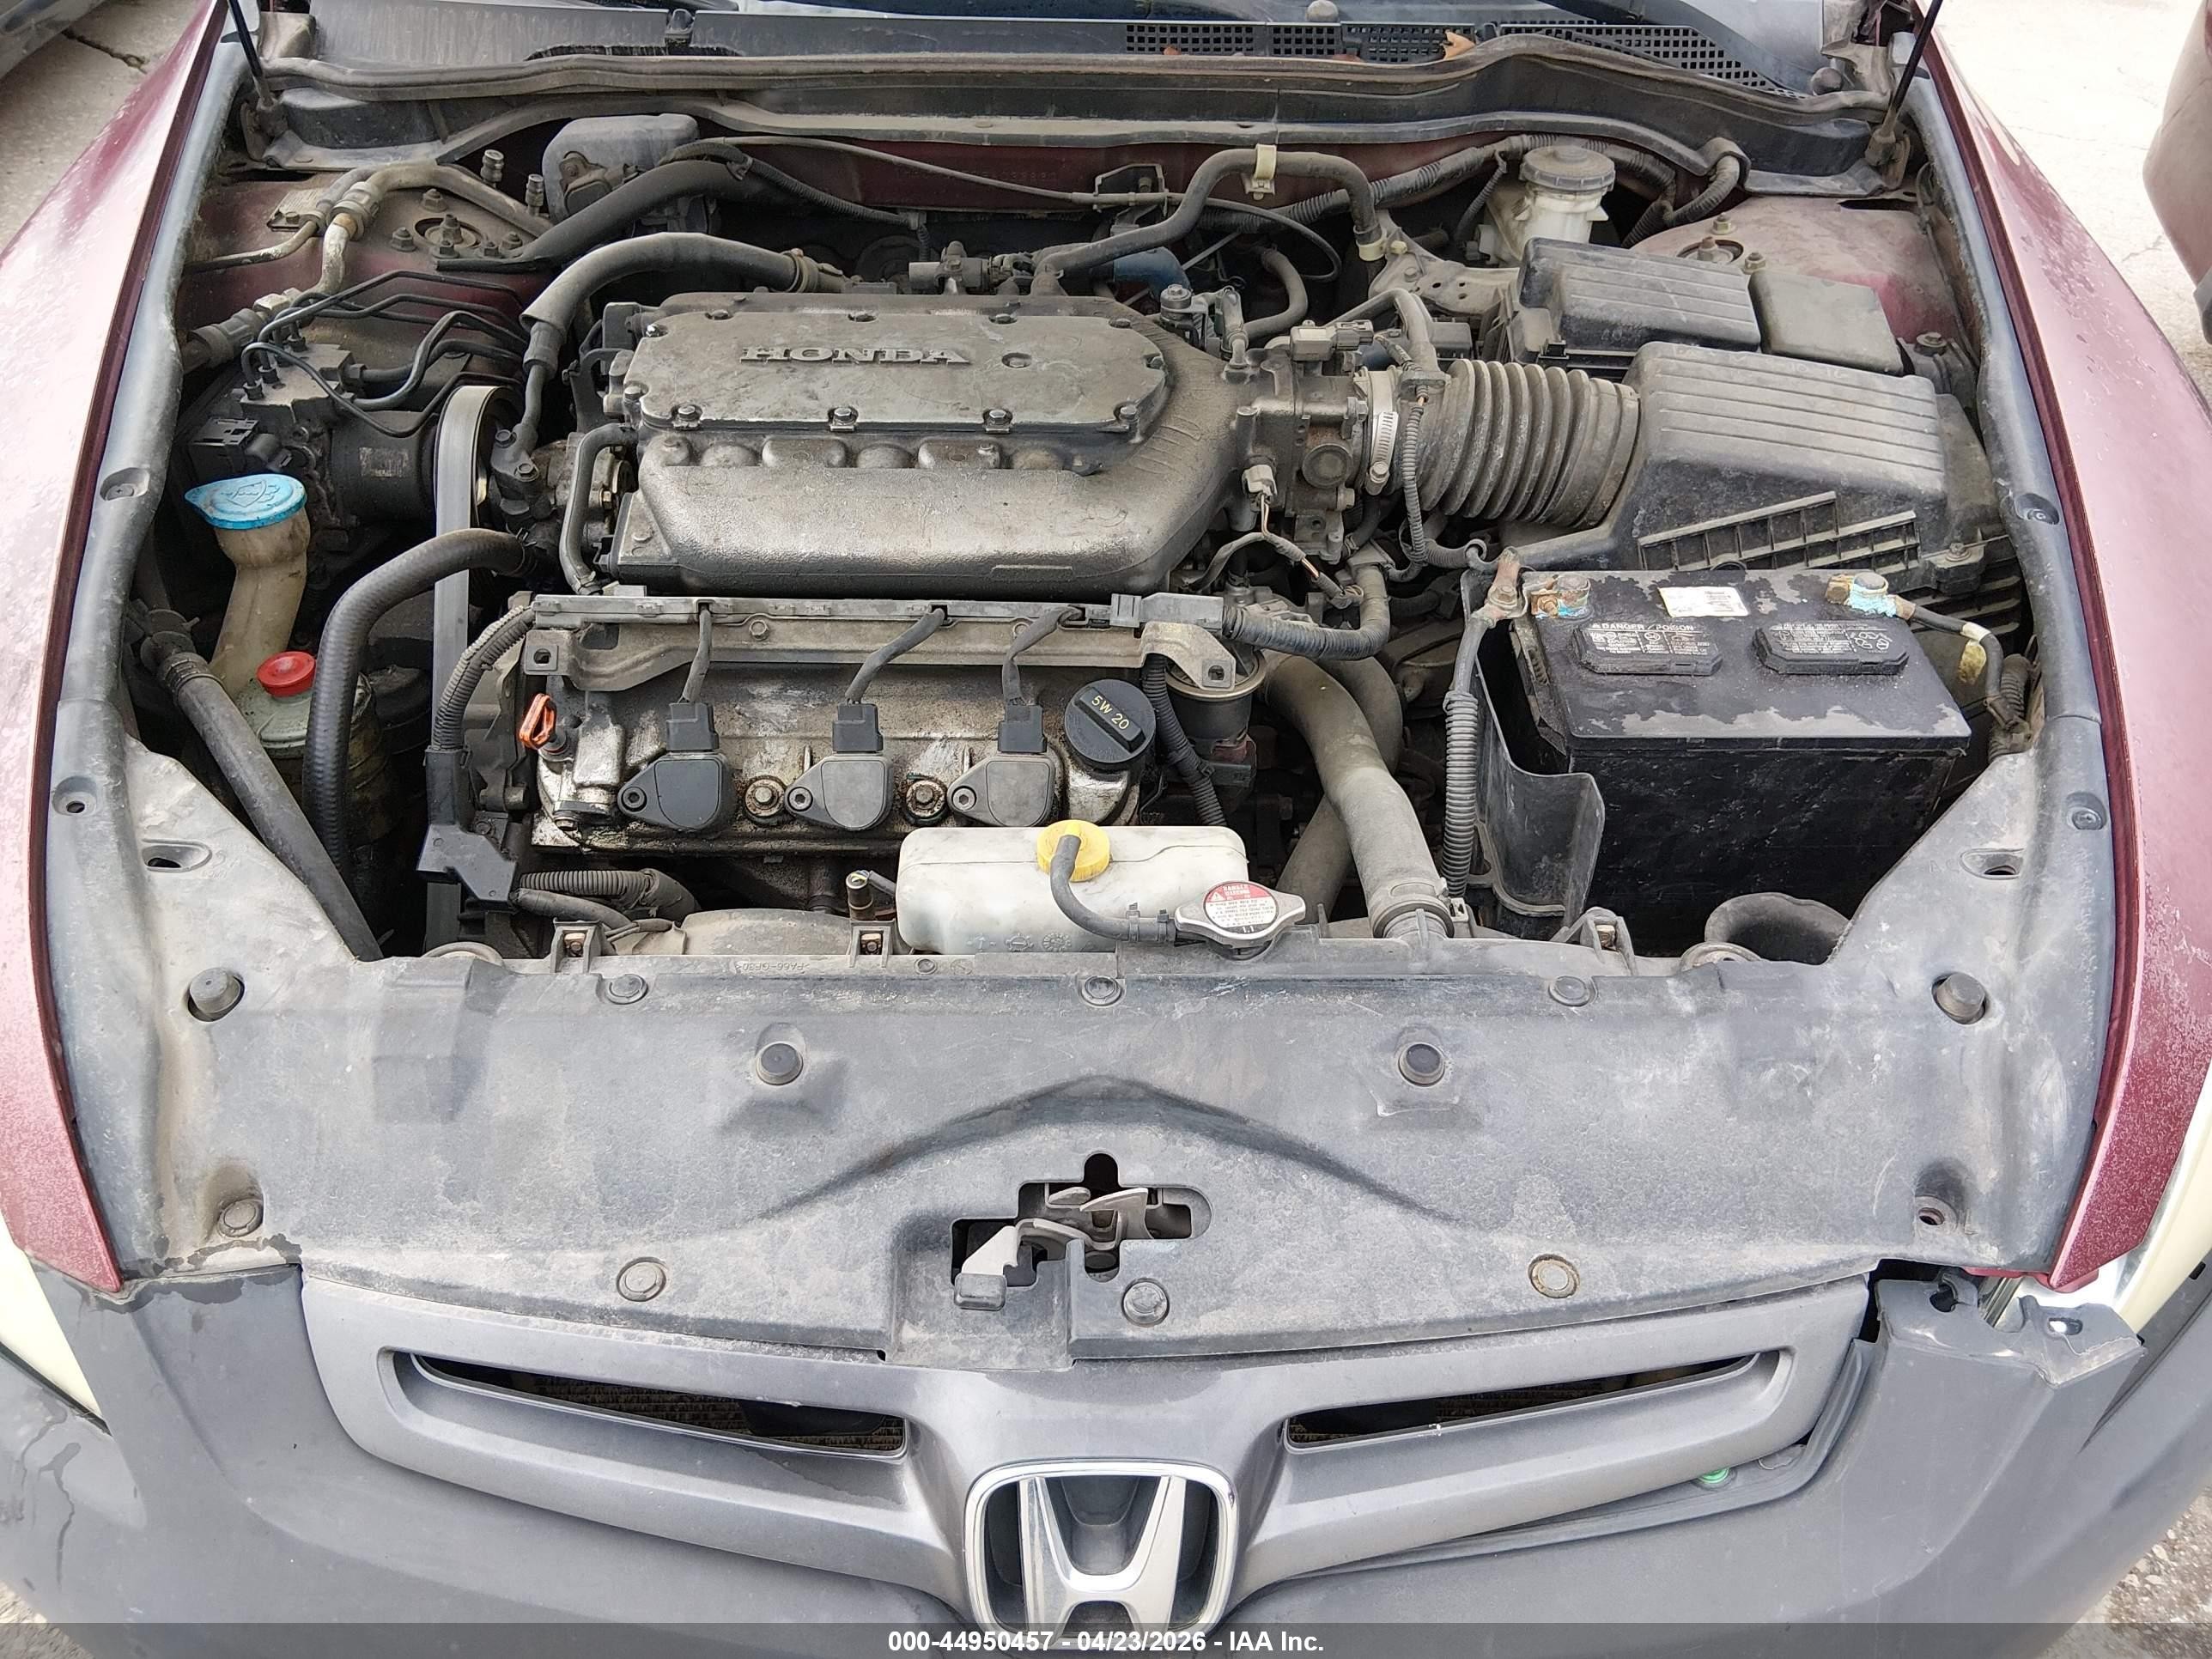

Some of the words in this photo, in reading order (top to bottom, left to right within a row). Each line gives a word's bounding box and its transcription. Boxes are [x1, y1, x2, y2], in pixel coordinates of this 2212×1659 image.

[739, 347, 970, 365] HONDA
[1091, 696, 1113, 714] 5W
[1111, 713, 1129, 730] 20
